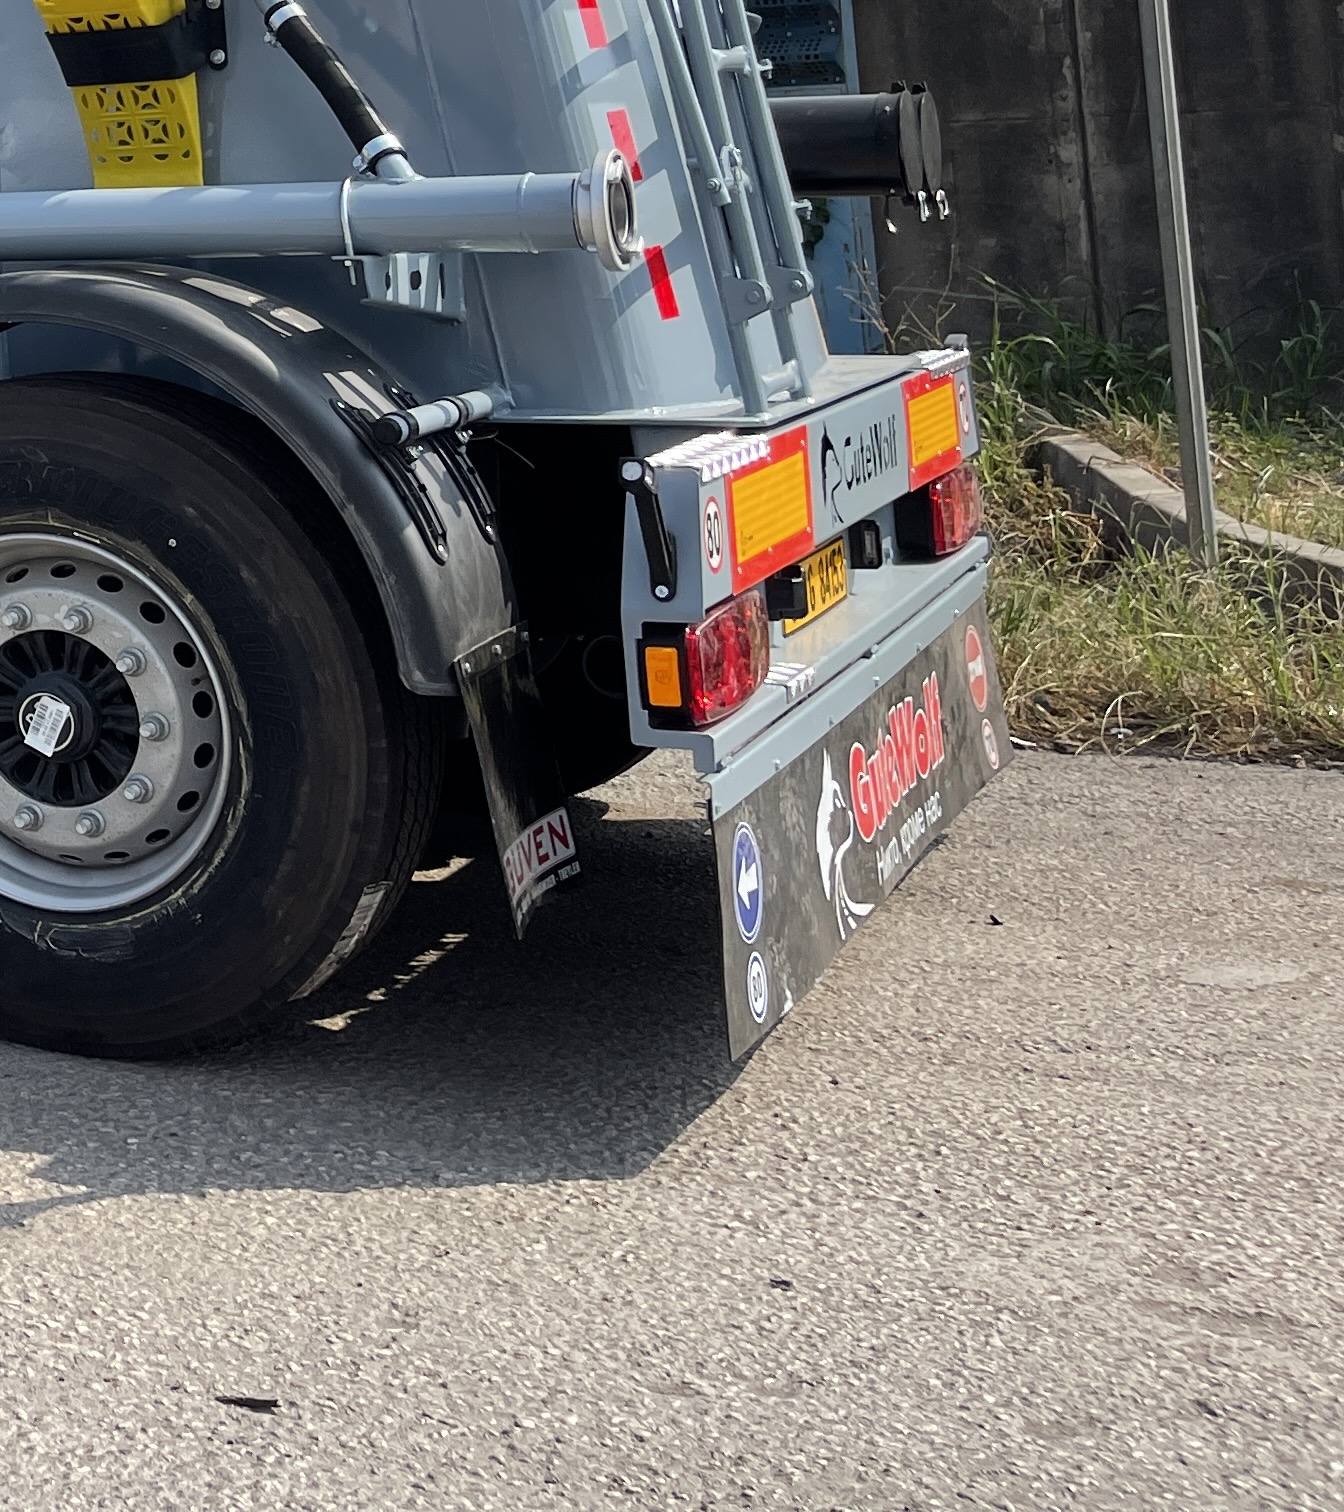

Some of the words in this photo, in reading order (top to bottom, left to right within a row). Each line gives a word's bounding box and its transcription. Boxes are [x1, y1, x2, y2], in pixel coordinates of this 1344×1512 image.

[843, 414, 897, 490] GuteWolf
[706, 510, 720, 559] 80
[849, 670, 945, 843] GuteWolf
